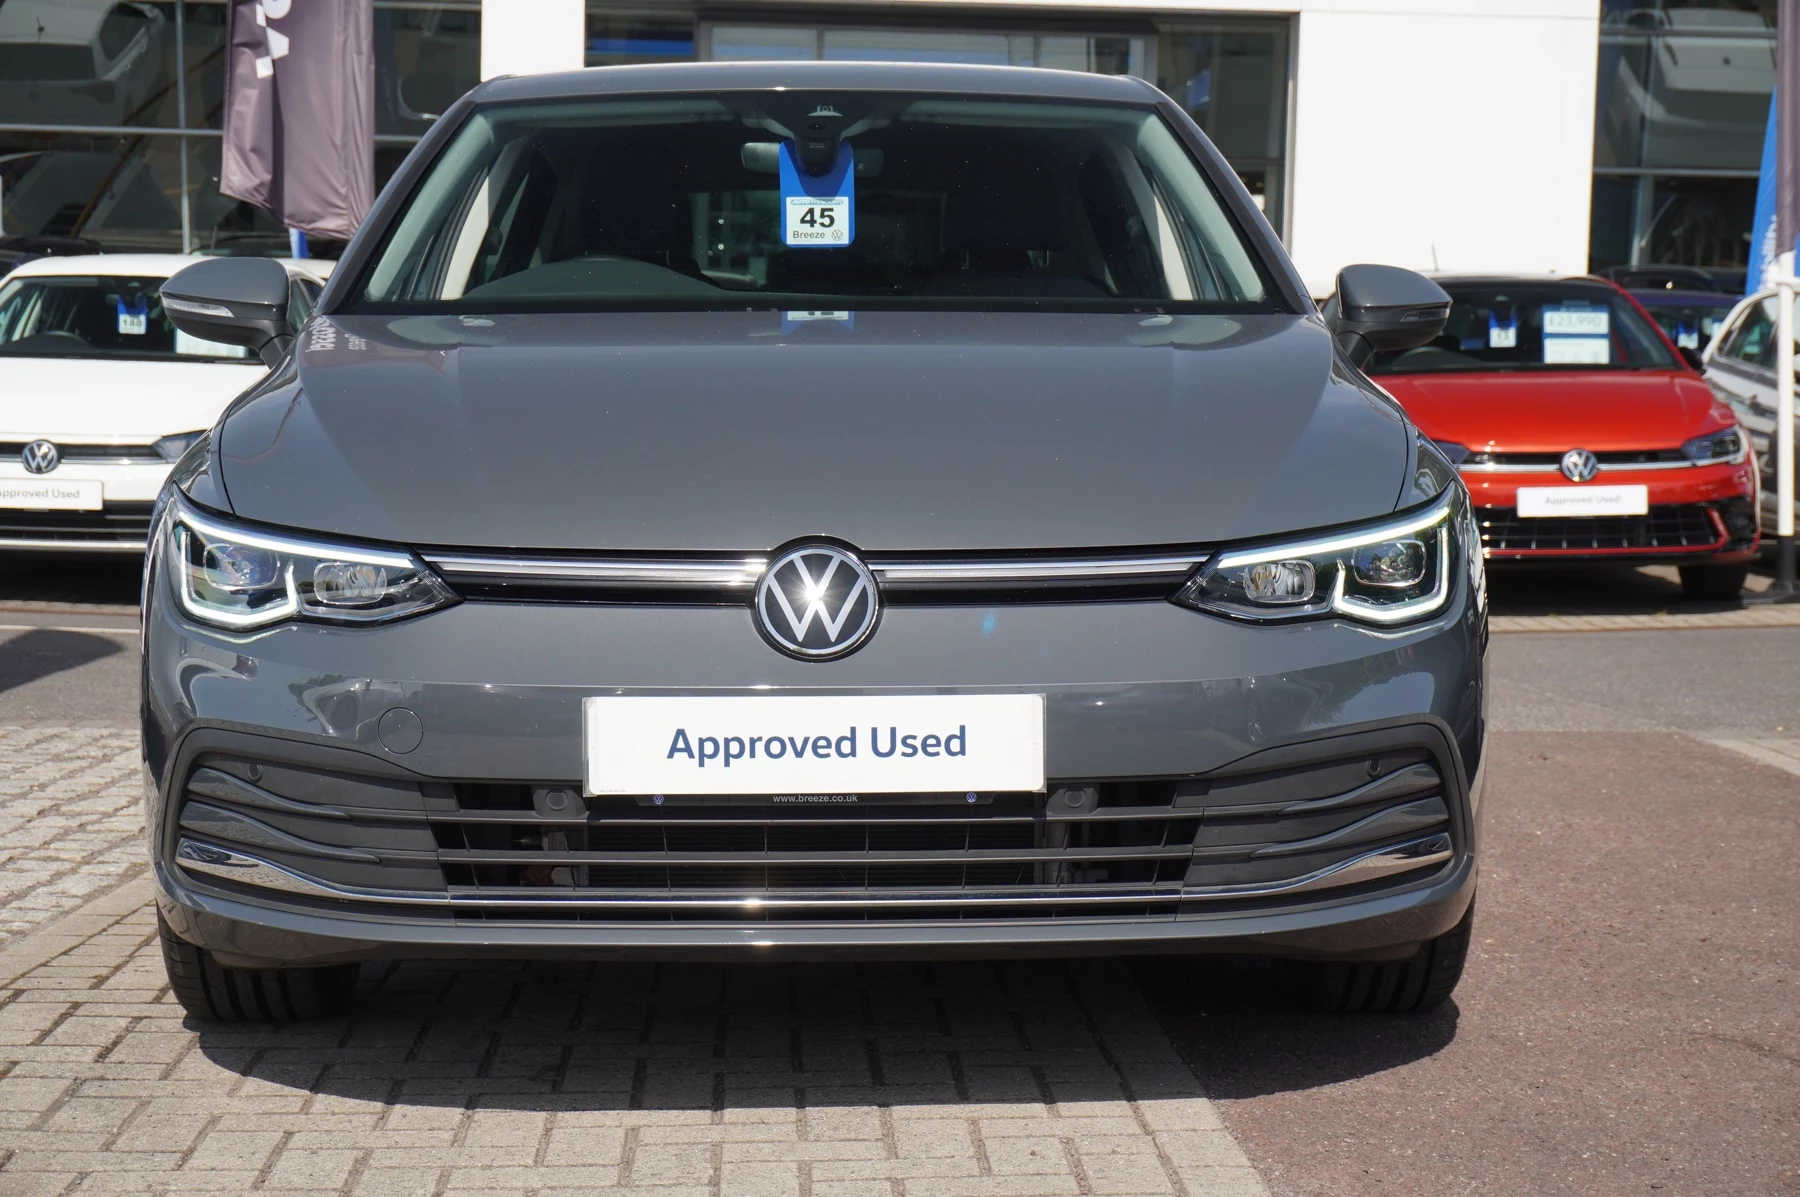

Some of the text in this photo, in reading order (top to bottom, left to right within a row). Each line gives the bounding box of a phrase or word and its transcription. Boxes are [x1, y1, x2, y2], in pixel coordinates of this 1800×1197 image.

[799, 207, 835, 228] 45
[792, 230, 826, 239] Breeze
[52, 489, 80, 498] Used
[667, 725, 967, 768] Approved Used
[773, 794, 858, 803] www.breeze.co.uk
